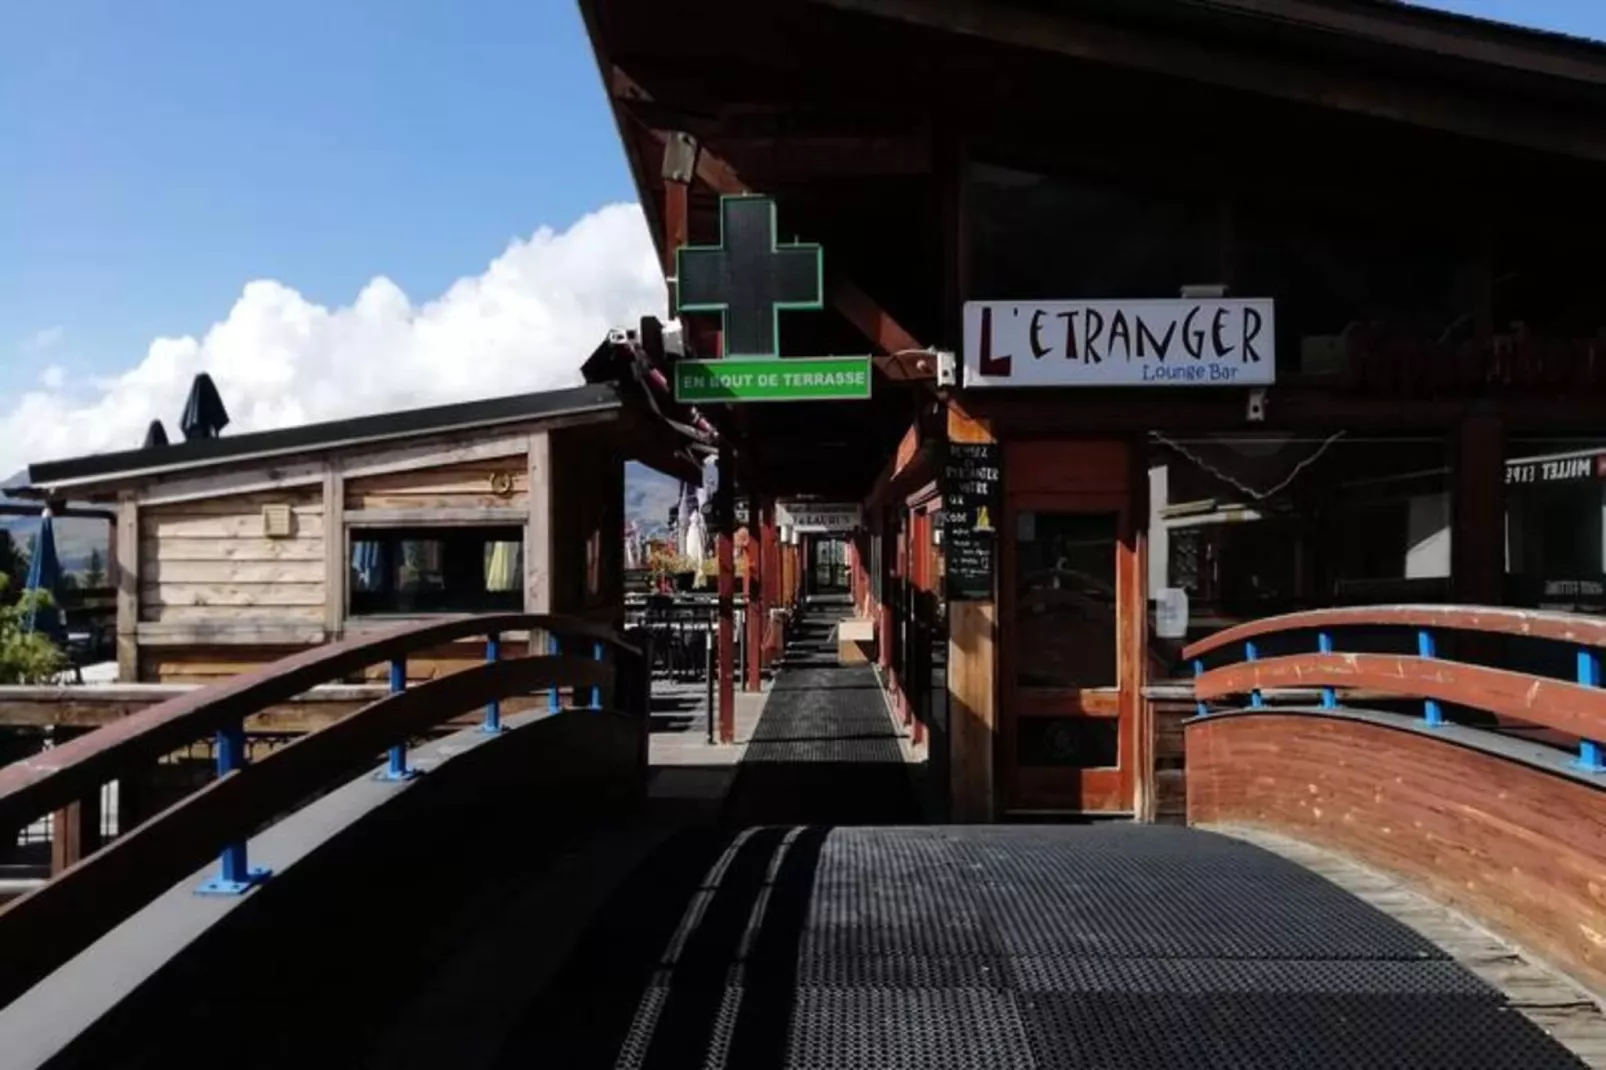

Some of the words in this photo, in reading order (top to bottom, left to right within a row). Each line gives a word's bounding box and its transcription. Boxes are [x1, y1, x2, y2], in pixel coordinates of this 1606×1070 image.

[979, 306, 1262, 377] L'ETRANGER
[683, 376, 705, 388] EN
[710, 374, 753, 388] BOUT
[758, 373, 778, 386] DE
[782, 371, 865, 386] TERRASSE
[1141, 363, 1206, 383] Lounge
[1209, 362, 1239, 381] Bar
